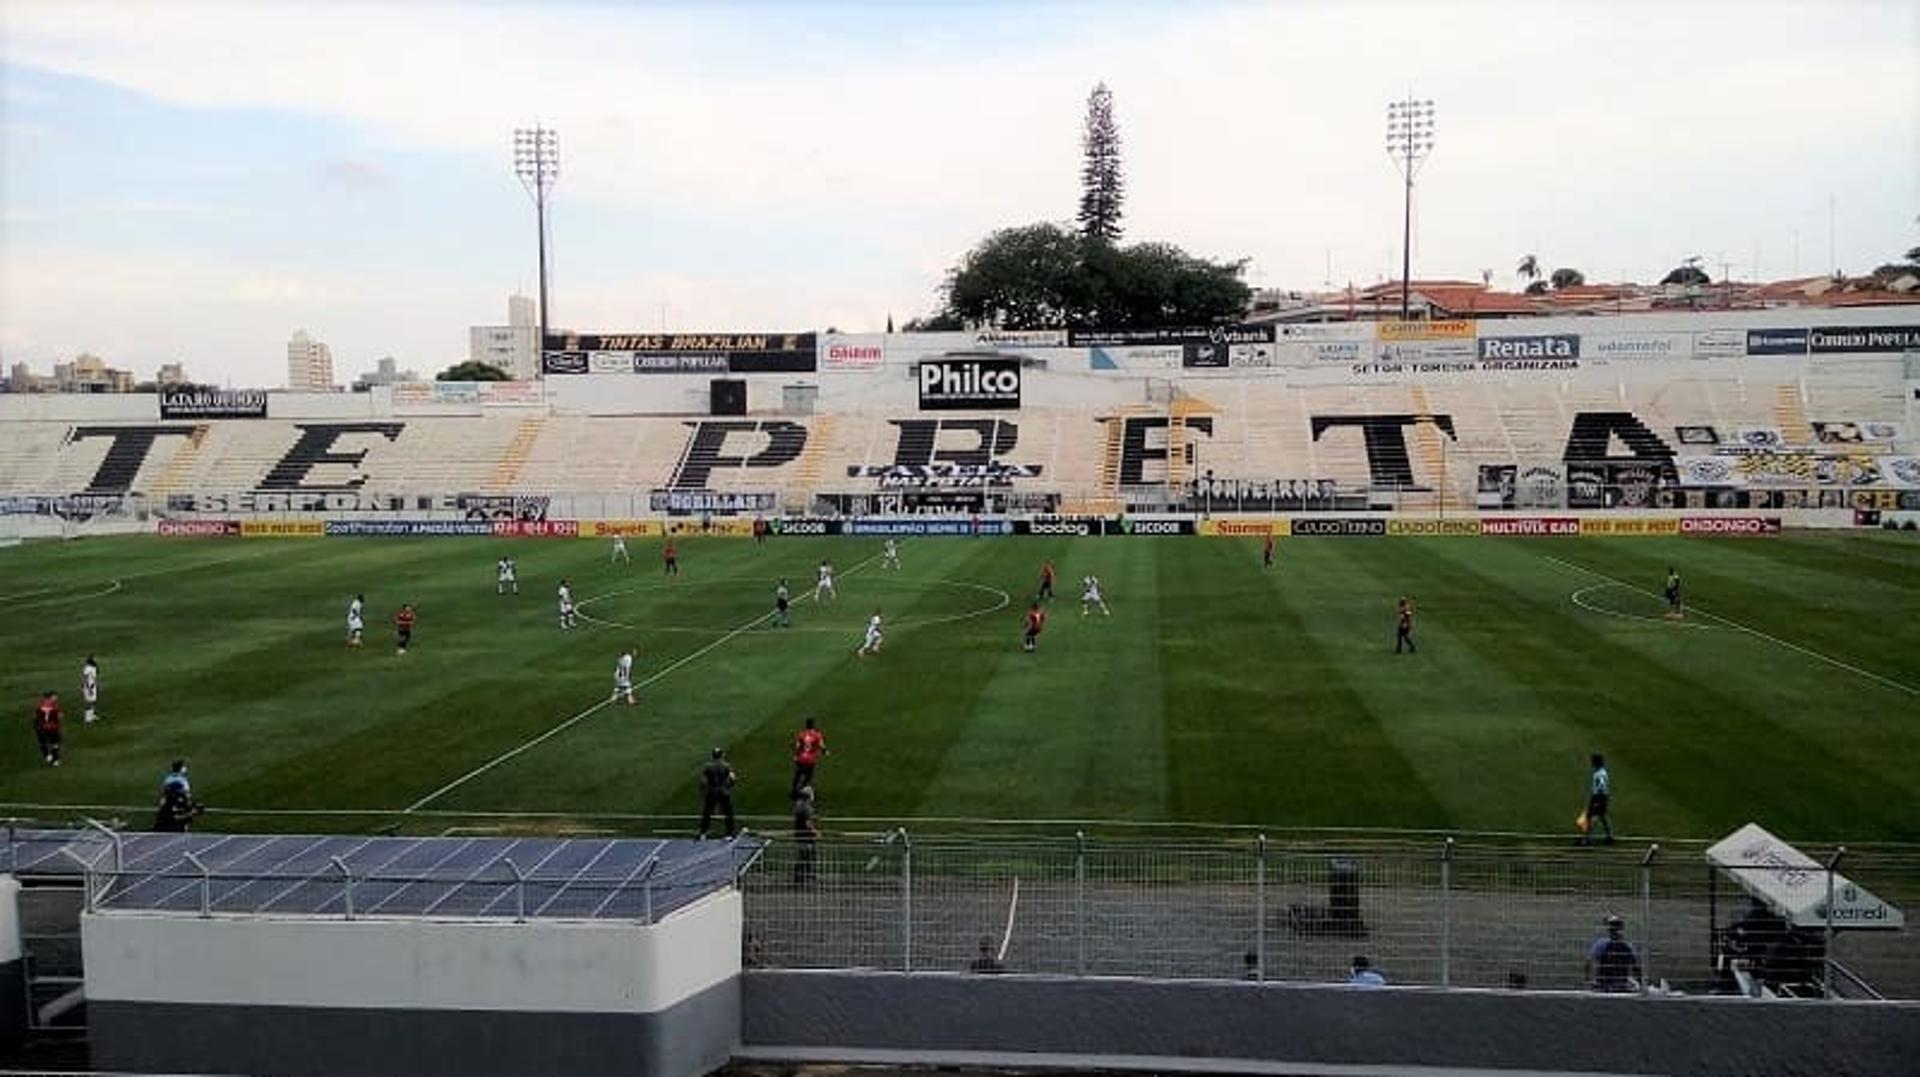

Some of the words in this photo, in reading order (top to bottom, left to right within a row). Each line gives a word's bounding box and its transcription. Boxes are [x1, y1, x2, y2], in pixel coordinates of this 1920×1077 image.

[600, 336, 664, 349] TINTAS
[671, 335, 767, 349] BRAZILIAN
[1485, 338, 1570, 358] Renata
[1352, 364, 1402, 374] SETOR
[1412, 362, 1475, 373] TORCIDA
[1482, 360, 1579, 371] ORGANIZADA
[920, 363, 1019, 393] Philco
[1029, 521, 1089, 535] bodog
